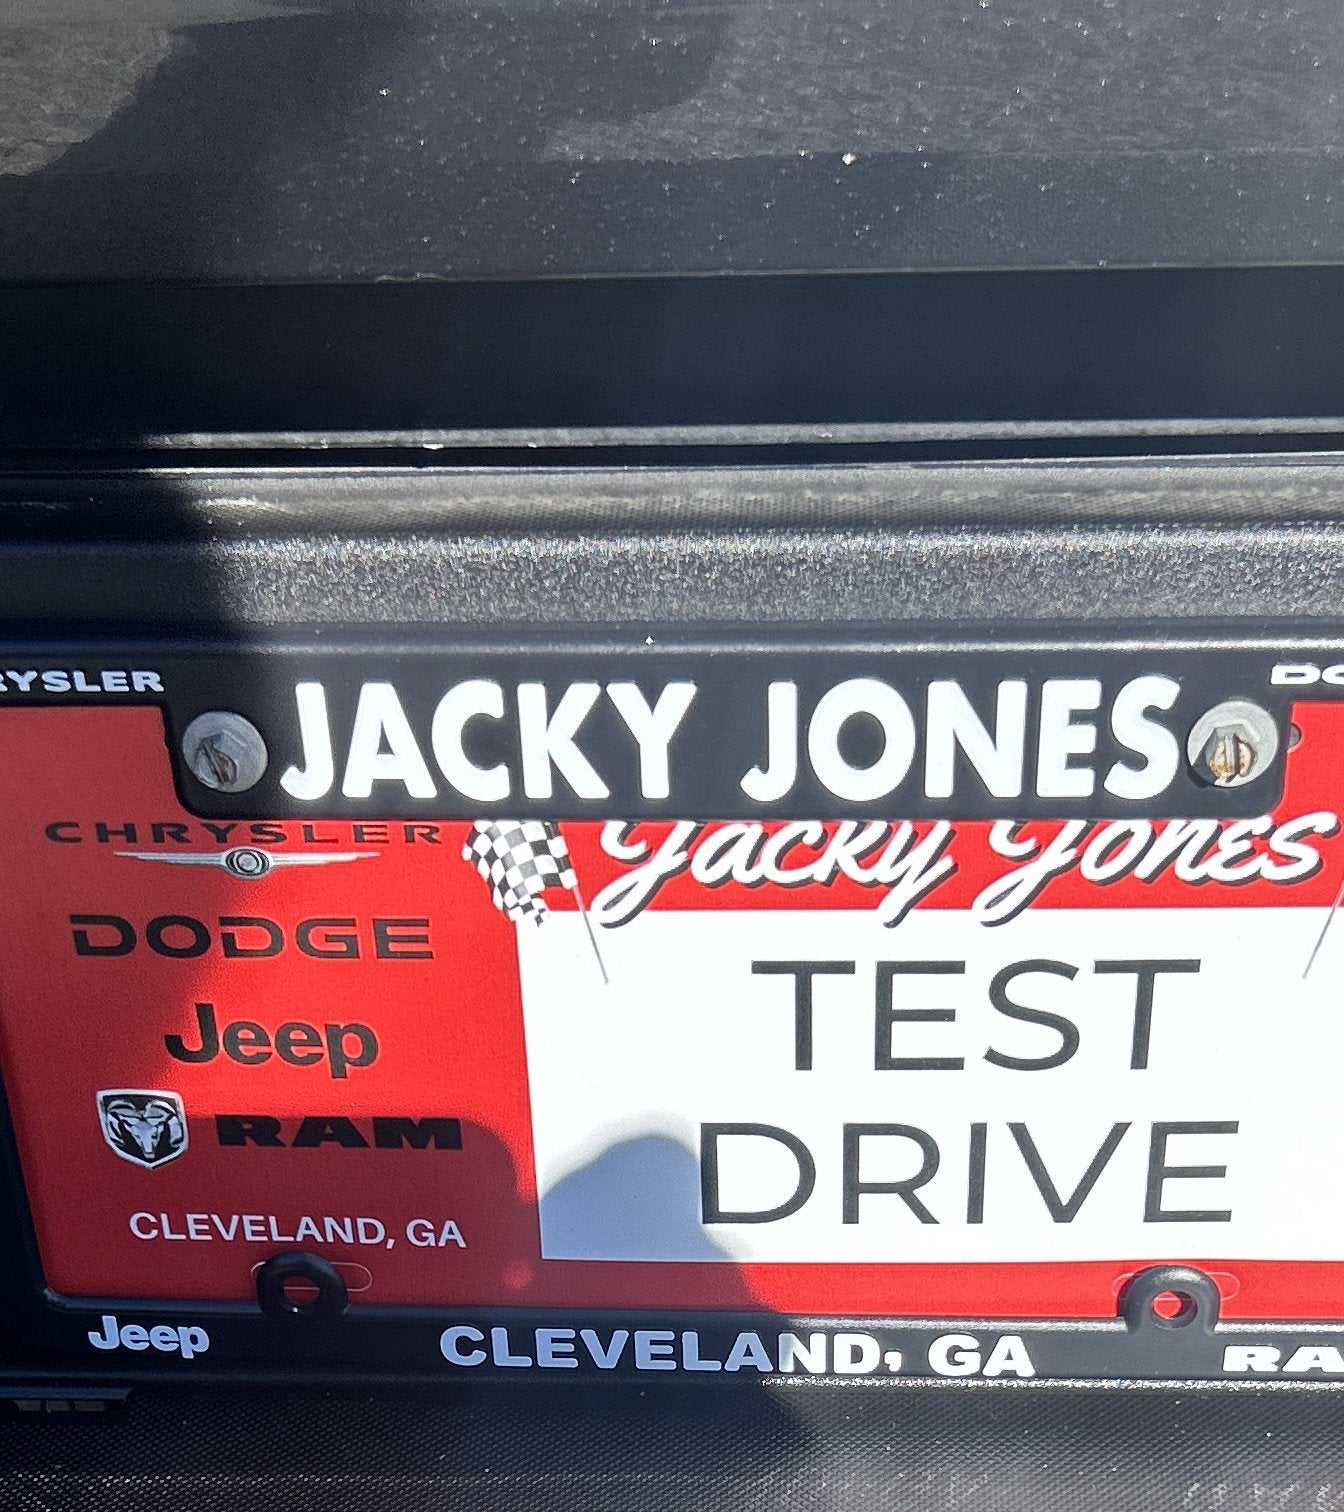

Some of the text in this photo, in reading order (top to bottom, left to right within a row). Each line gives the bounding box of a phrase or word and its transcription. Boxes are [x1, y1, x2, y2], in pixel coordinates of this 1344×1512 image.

[278, 674, 1182, 802] JACKY JONES
[44, 821, 444, 845] CHRYSLER
[592, 812, 1341, 928] Jacky Jones
[68, 914, 434, 960] DODGE
[164, 1003, 379, 1078] Jeep
[751, 959, 1201, 1071] TEST
[216, 1114, 463, 1150] RAM
[701, 1120, 1239, 1225] DRIVE
[130, 1212, 467, 1251] CLEVELAND, GA
[89, 1316, 210, 1359] Jeep
[439, 1325, 1036, 1377] CLEVELAND, GA
